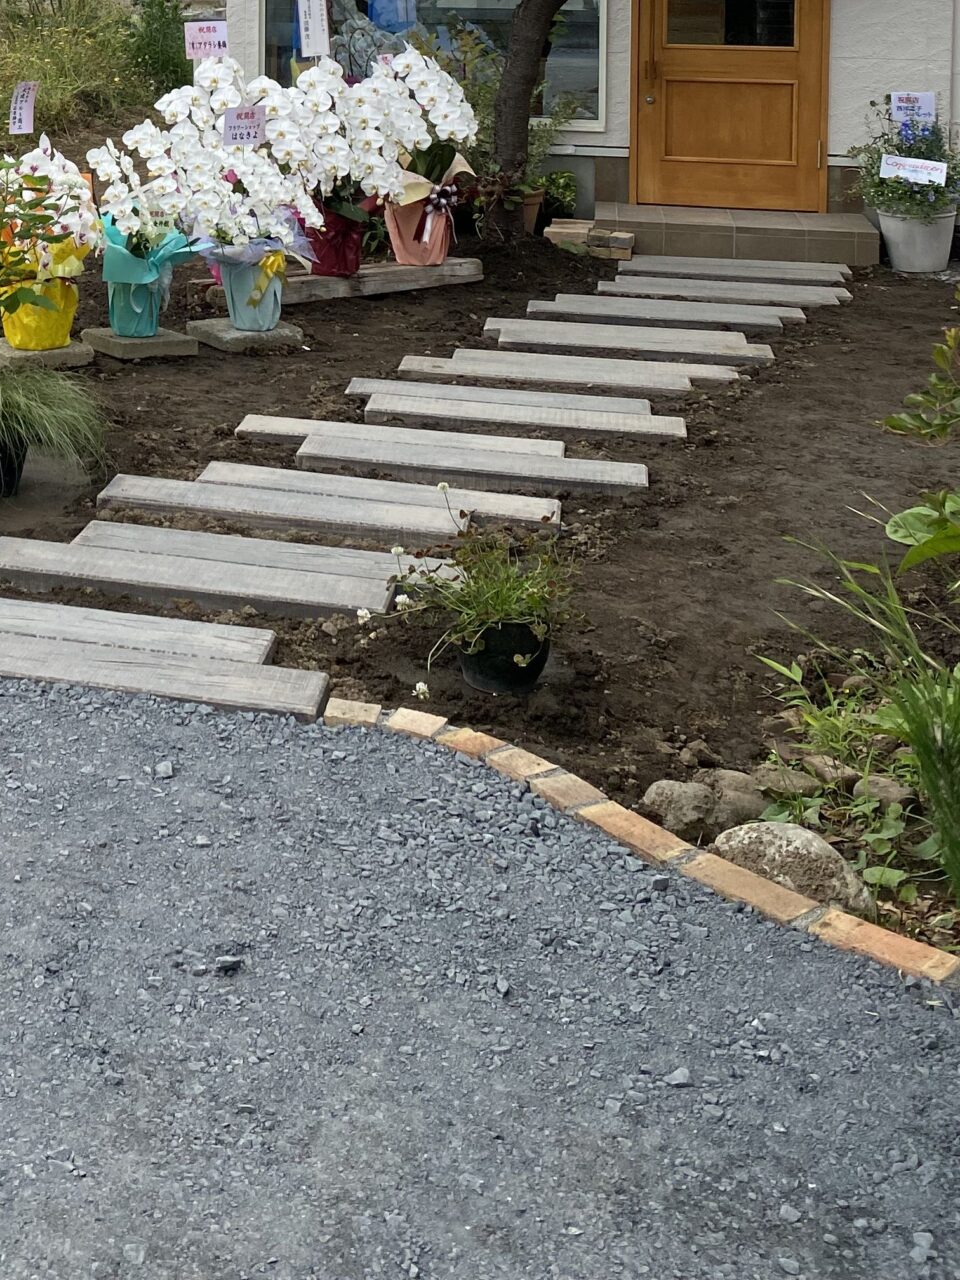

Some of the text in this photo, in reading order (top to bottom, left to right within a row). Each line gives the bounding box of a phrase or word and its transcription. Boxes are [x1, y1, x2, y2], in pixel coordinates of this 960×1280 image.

[236, 111, 256, 121] 祝開店
[228, 123, 261, 132] フラワーショップ
[231, 131, 258, 140] はなきよ
